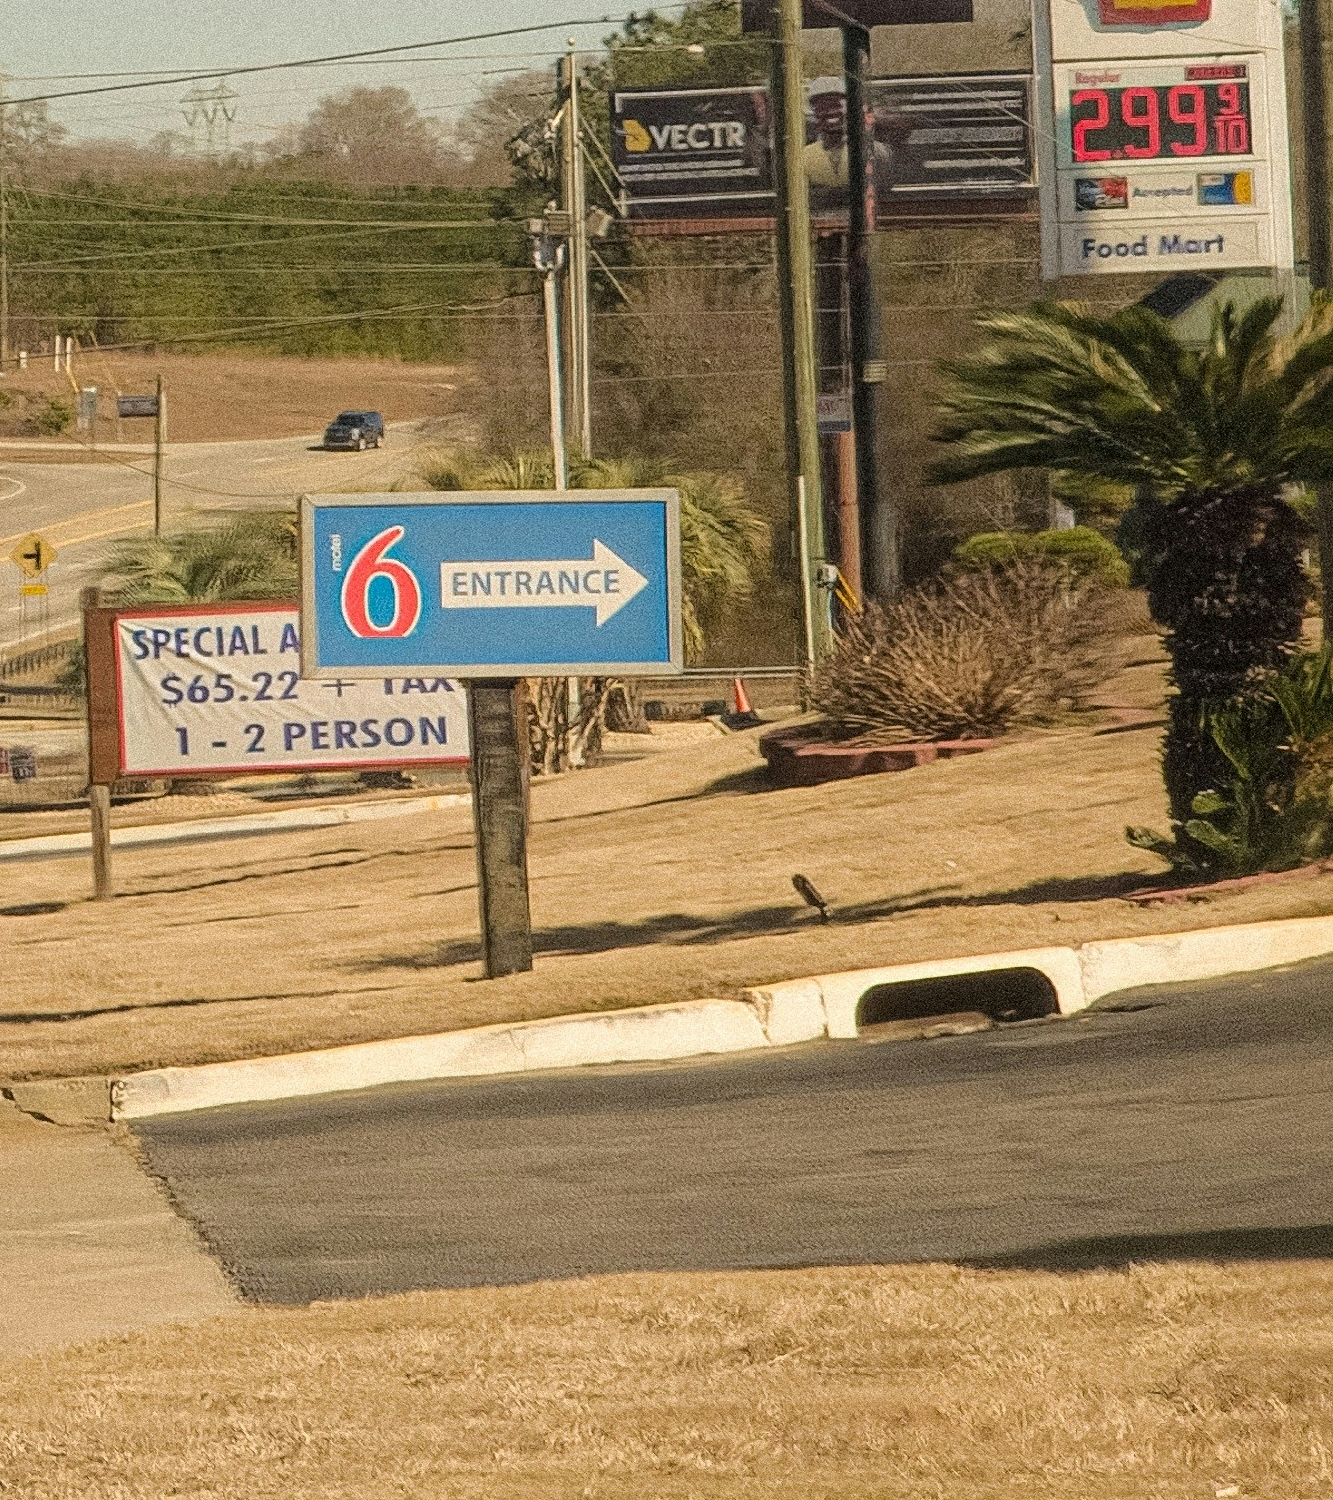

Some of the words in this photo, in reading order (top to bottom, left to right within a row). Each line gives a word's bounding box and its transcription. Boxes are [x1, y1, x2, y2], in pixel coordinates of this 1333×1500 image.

[649, 121, 746, 151] VECTR
[1082, 235, 1148, 259] Food
[1159, 233, 1225, 256] Mart
[340, 524, 422, 639] 6
[451, 568, 621, 597] ENTRANCE
[131, 624, 268, 660] SPECIAL
[160, 671, 300, 708] $65.22
[243, 723, 266, 753] 2
[283, 715, 448, 751] PERSON
